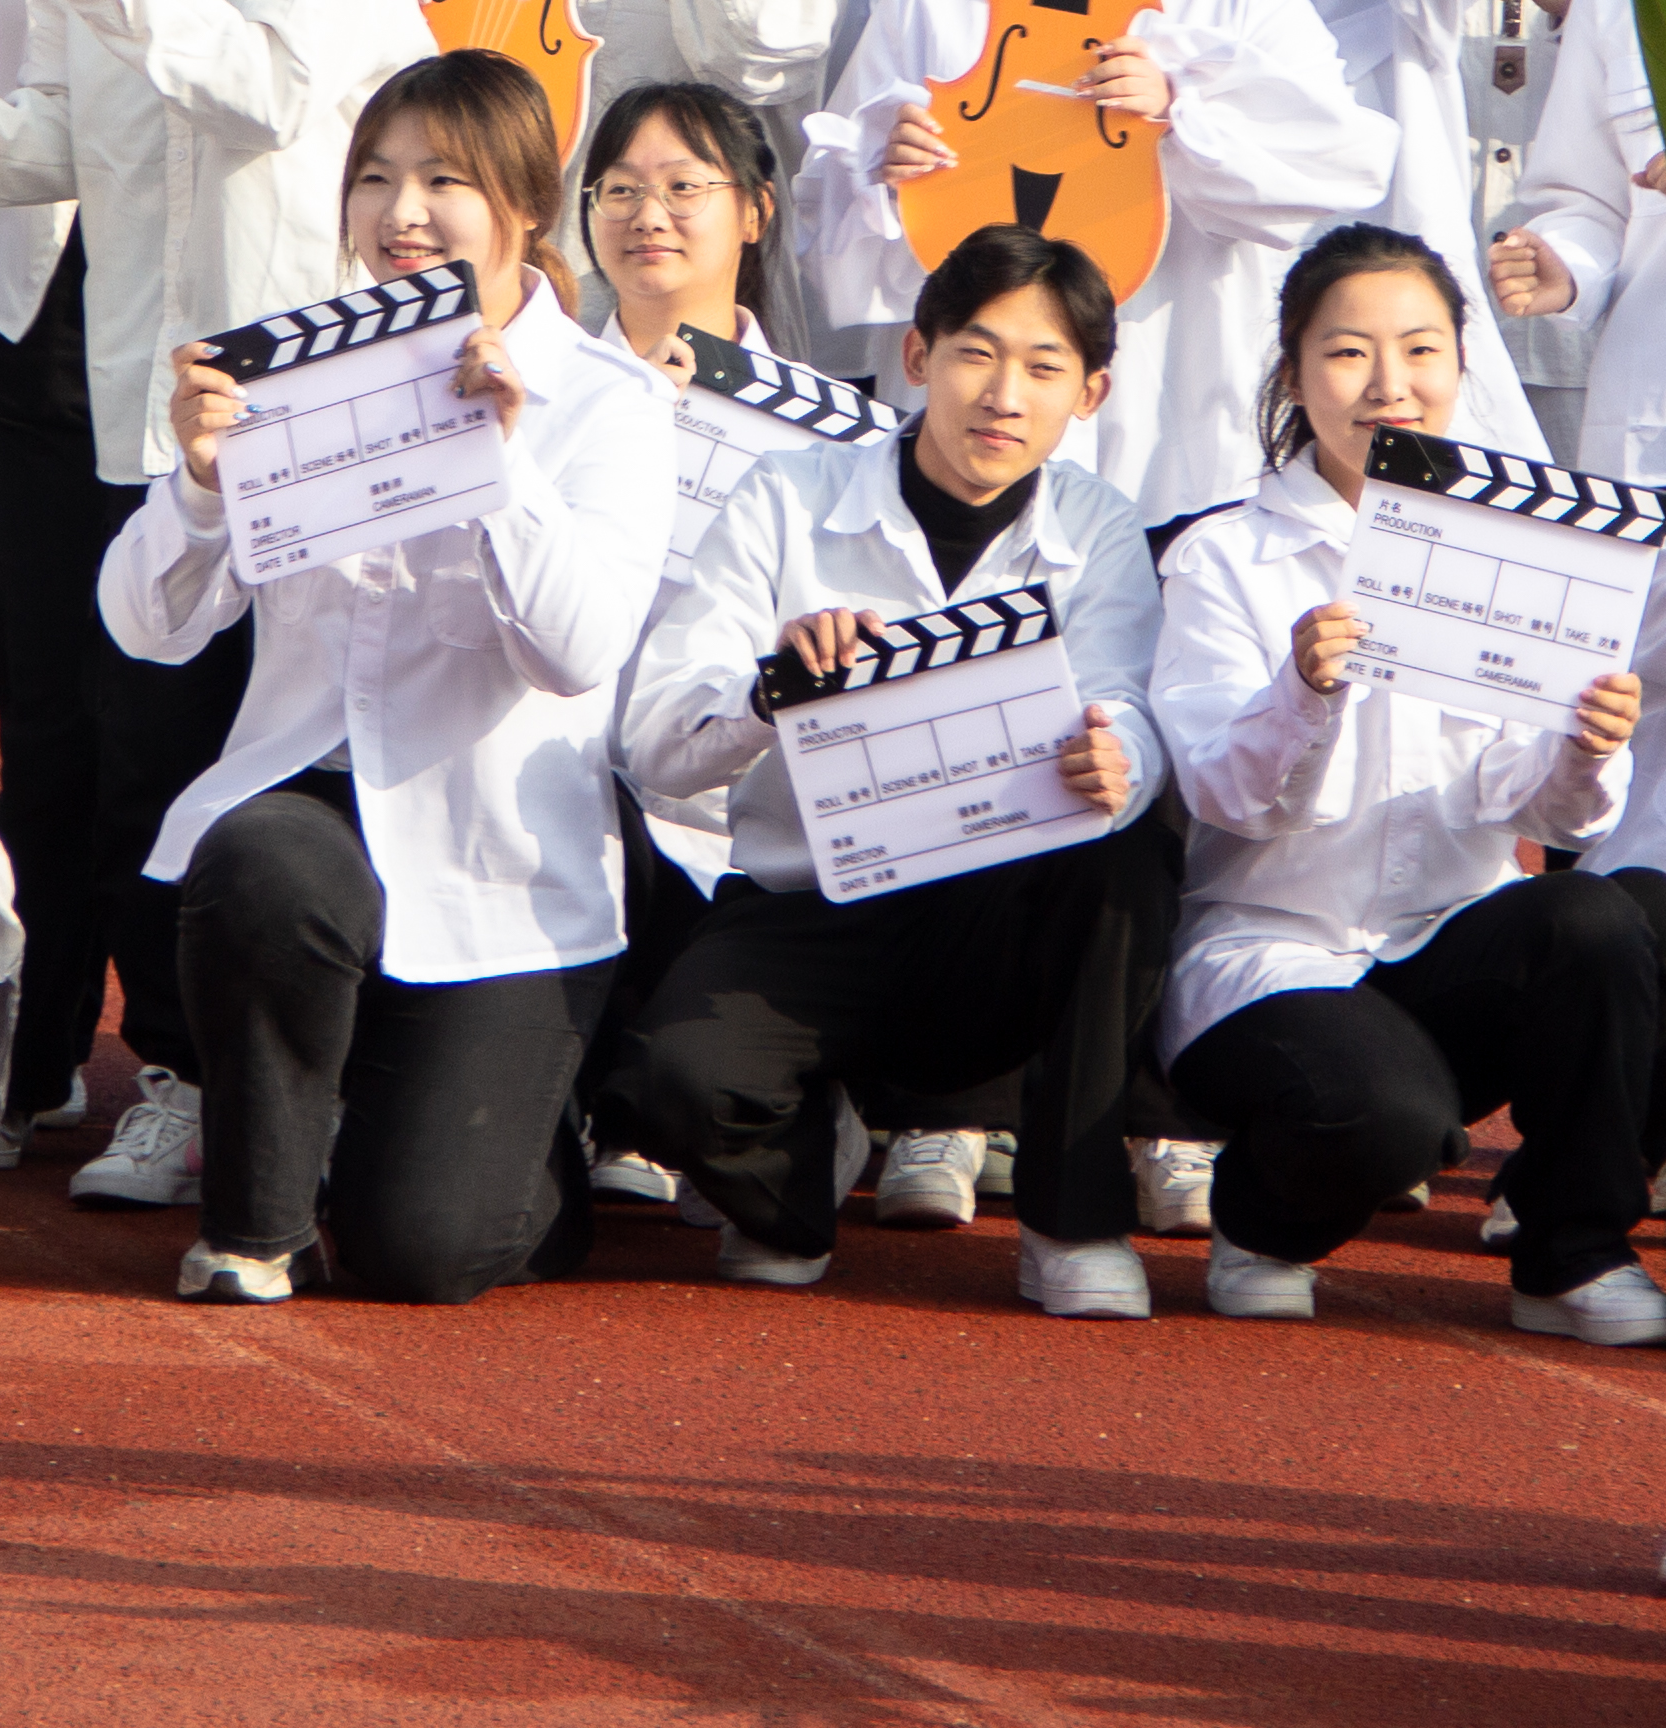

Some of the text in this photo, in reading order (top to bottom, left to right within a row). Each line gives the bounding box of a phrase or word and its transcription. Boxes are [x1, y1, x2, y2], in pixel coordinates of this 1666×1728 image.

[300, 455, 334, 473] SCENE
[1378, 499, 1403, 514] 片名
[1373, 513, 1444, 539] PRODUCTION
[250, 525, 301, 548] DIRECTOR
[255, 557, 281, 572] DATE
[1356, 576, 1383, 593] ROLL
[1424, 592, 1460, 612] SCENE
[1493, 609, 1524, 627] SHOT
[1564, 627, 1592, 644] TAKE
[1344, 661, 1368, 676] ATE
[1475, 667, 1543, 693] CAMERAMAN
[798, 722, 868, 747] PRODUCTION
[1020, 742, 1049, 758] TAKE
[949, 760, 979, 777] SHOT
[881, 776, 918, 794] SCENE
[814, 795, 843, 811] ROLL
[960, 809, 1031, 835] CAMERAMAN
[833, 845, 888, 869] DIRECTOR
[838, 876, 870, 893] DATE
